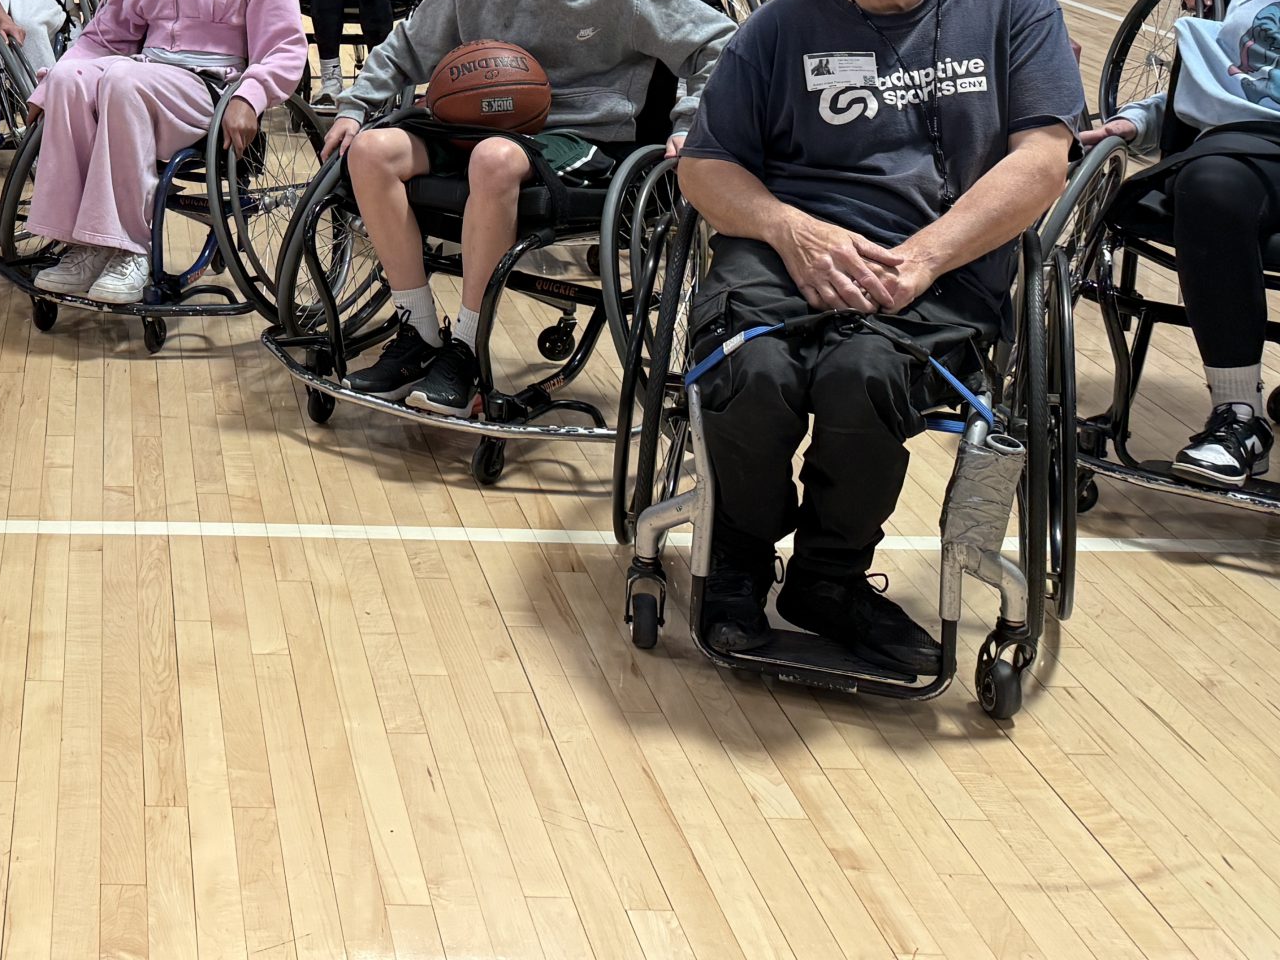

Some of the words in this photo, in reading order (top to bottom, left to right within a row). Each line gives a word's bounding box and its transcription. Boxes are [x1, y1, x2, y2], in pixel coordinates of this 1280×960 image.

[448, 55, 530, 83] SPALDING
[877, 57, 985, 91] adaptive
[882, 81, 956, 111] sports
[959, 80, 984, 89] CNY
[535, 279, 577, 297] QUICKIE
